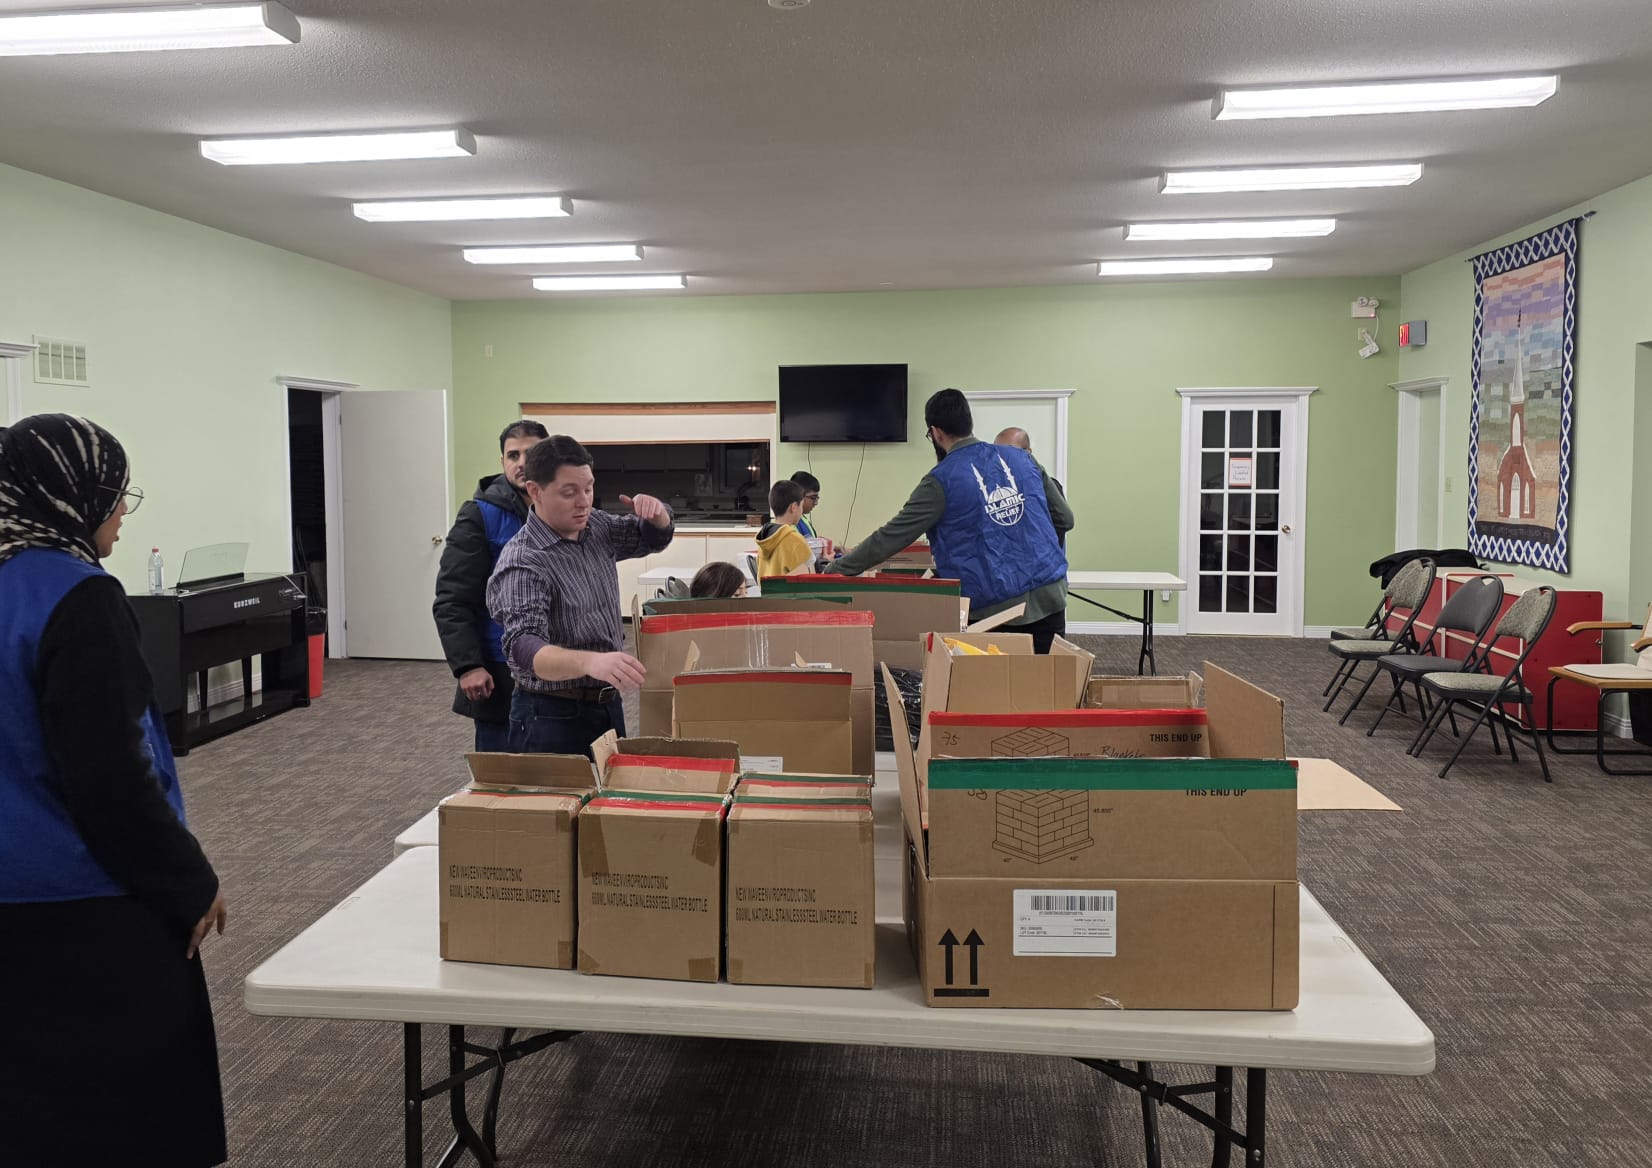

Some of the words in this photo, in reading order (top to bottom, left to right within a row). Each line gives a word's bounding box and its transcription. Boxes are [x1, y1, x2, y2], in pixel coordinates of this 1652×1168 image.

[984, 493, 1026, 514] ISLAMIC
[996, 506, 1020, 520] RELIEF
[1149, 733, 1169, 742] THIS
[1171, 733, 1188, 742] END
[1190, 733, 1202, 742] UP
[1185, 788, 1208, 797] THIS
[1210, 788, 1230, 797] END
